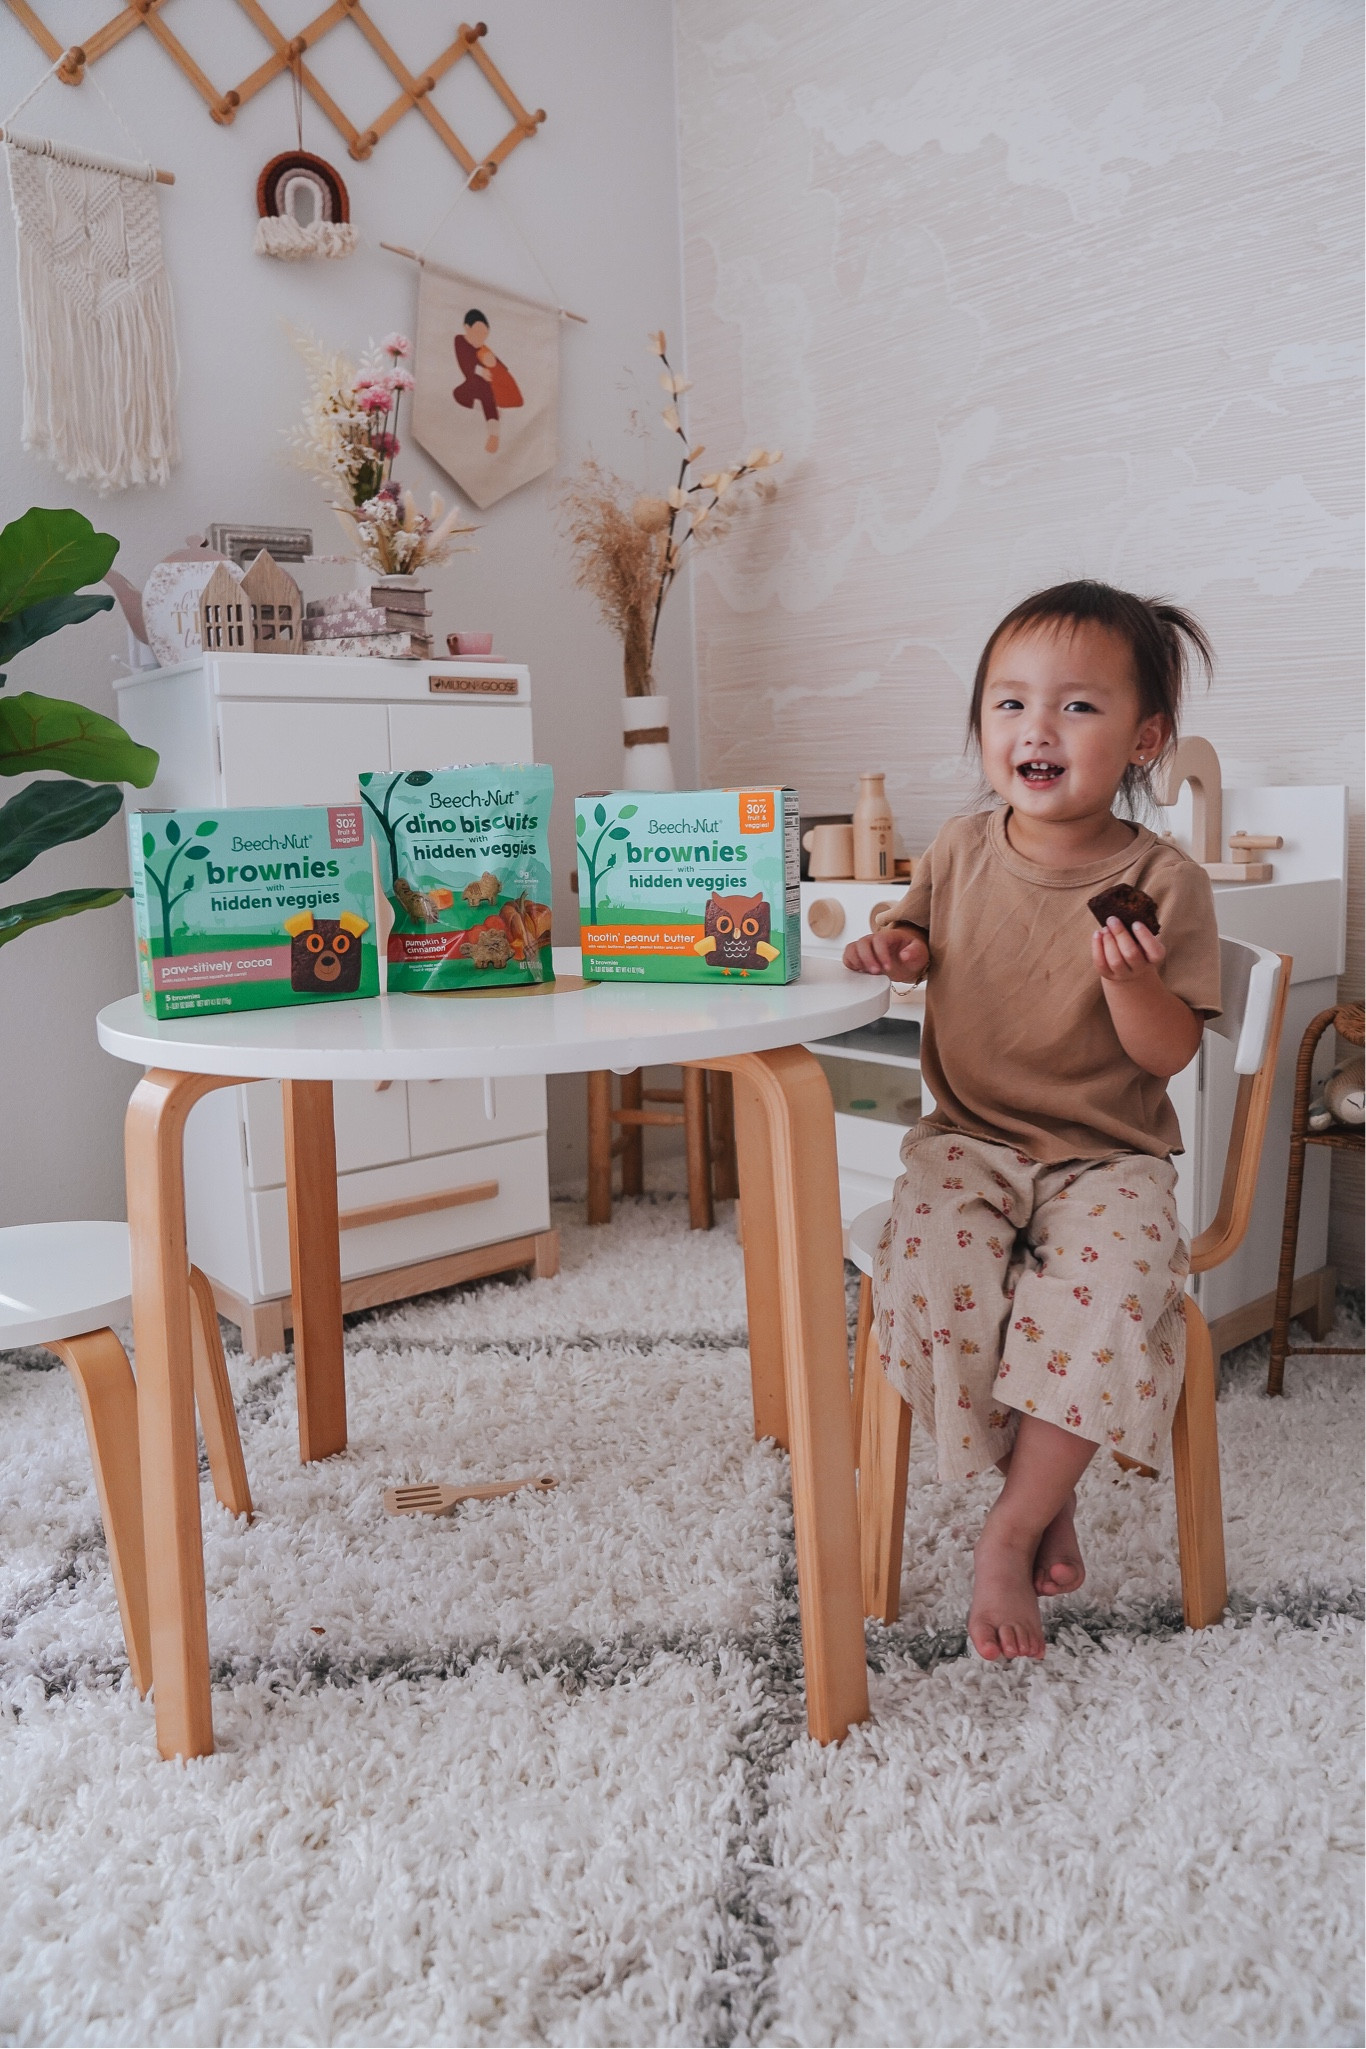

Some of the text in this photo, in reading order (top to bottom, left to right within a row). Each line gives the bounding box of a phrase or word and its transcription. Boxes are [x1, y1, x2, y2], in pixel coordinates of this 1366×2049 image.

[441, 680, 476, 690] MILTON
[481, 681, 516, 692] GOOSE
[429, 790, 514, 808] Beech-Nut
[747, 804, 766, 814] 30%
[336, 819, 356, 828] 30%
[406, 812, 538, 834] dino biscuits
[648, 819, 719, 834] Beech-Nut
[232, 835, 309, 851] Beech-Nut
[414, 840, 536, 860] hidden veggies
[627, 840, 748, 863] brownies
[207, 857, 339, 884] brownies
[266, 883, 284, 892] with
[630, 875, 746, 890] hidden veggies
[211, 891, 339, 912] hidden veggies
[406, 938, 439, 947] pumpkin
[588, 933, 695, 944] hootin' peanut butter
[162, 958, 272, 978] paw-sitively cocoa
